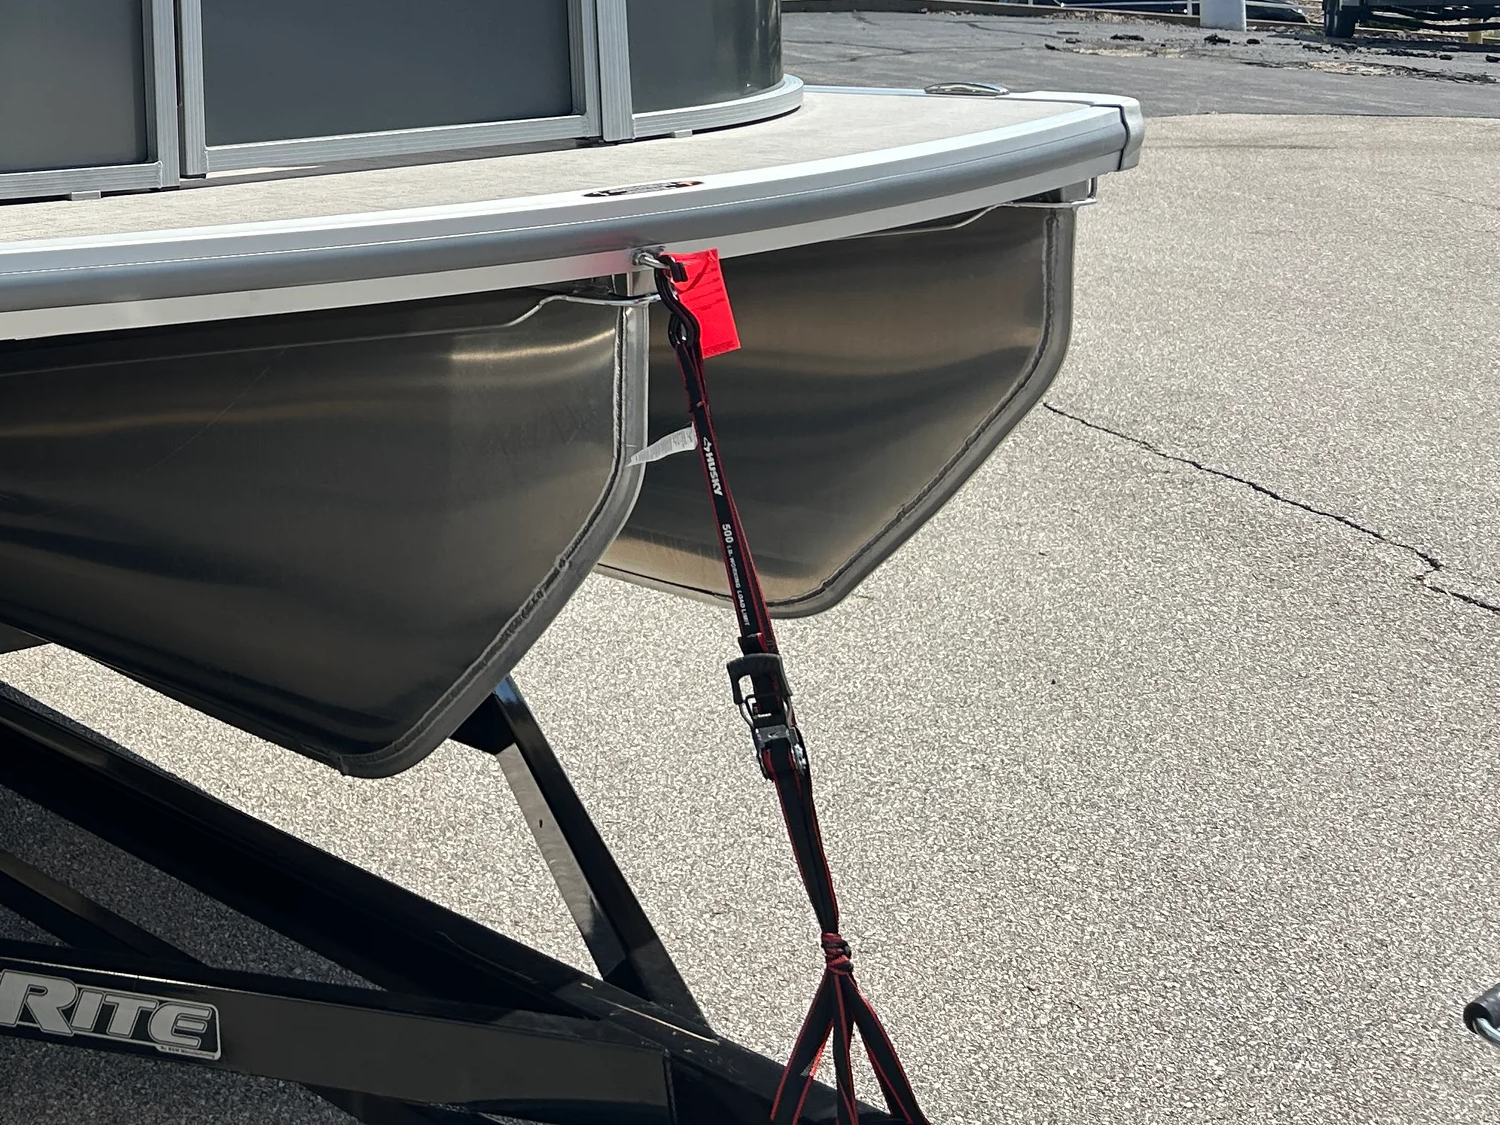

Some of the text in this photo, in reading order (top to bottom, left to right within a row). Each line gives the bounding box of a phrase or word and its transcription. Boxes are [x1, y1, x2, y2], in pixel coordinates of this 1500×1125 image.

[705, 452, 723, 496] HUSKY
[722, 523, 734, 544] 500
[736, 590, 746, 608] LOAD
[740, 608, 751, 626] LIMIT
